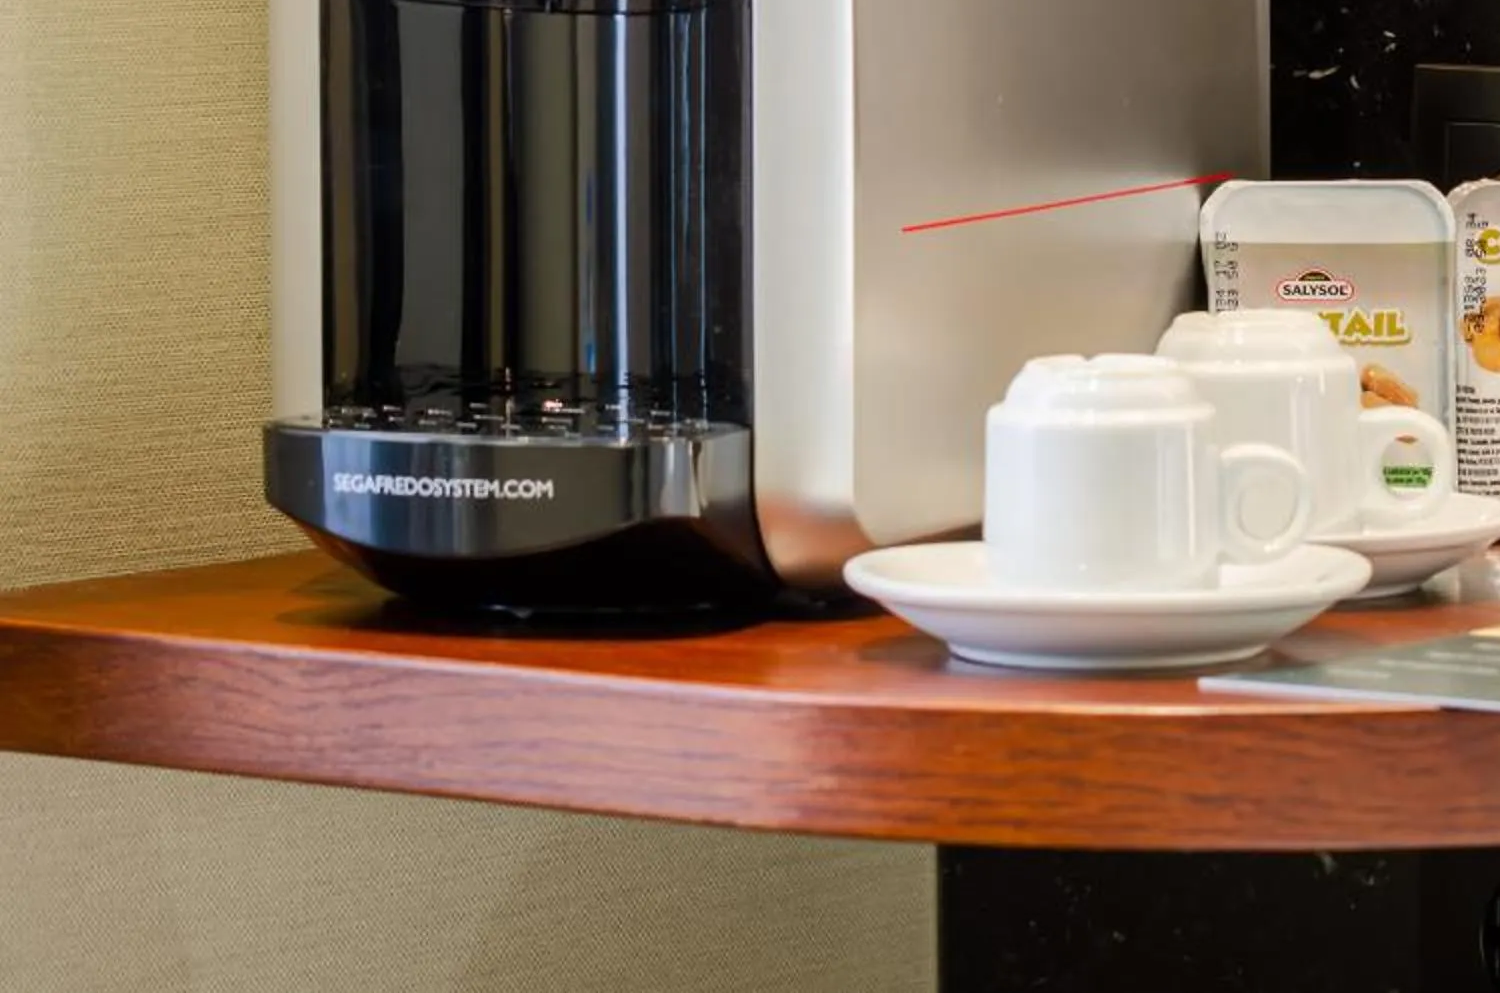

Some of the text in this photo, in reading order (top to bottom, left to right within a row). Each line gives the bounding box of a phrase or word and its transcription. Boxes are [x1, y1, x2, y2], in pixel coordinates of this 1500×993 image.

[1282, 284, 1349, 296] SALYSOL
[1318, 310, 1407, 340] TAIL
[333, 472, 555, 500] SEGAFREDOSYSTEM.COM
